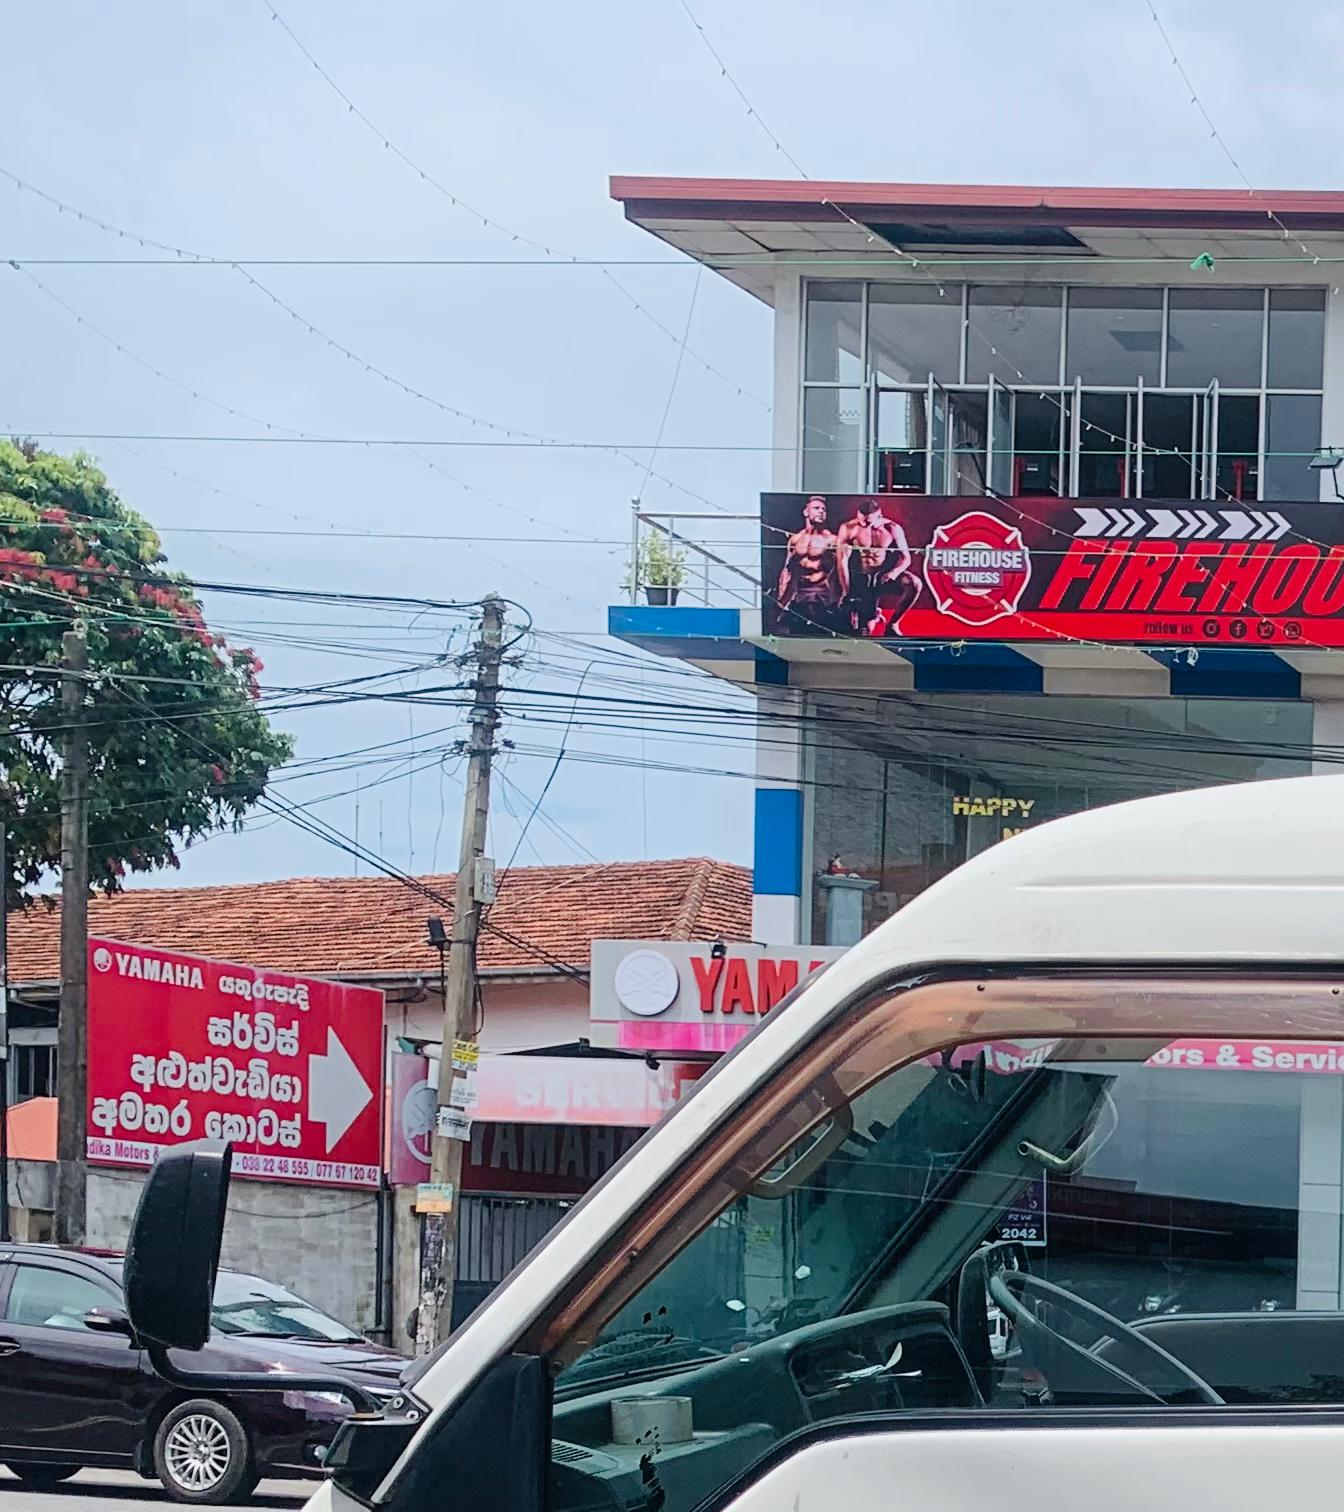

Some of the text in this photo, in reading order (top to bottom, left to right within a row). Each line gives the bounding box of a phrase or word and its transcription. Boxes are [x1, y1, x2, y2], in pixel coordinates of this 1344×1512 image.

[932, 549, 1023, 568] FIREHOUSE
[954, 571, 999, 584] FITNESS
[953, 797, 1036, 818] HAPPY
[115, 952, 204, 990] YAMAHA
[689, 956, 825, 1016] YAM
[1216, 1045, 1240, 1066] &
[91, 1091, 192, 1136] අමතර
[87, 1139, 111, 1156] dika
[114, 1141, 150, 1160] Motors
[263, 1158, 274, 1172] 22
[277, 1159, 288, 1173] 48
[292, 1161, 309, 1175] 555
[316, 1163, 333, 1178] 077
[335, 1165, 346, 1179] 67
[367, 1168, 378, 1182] 42
[1001, 1228, 1037, 1239] 2042
